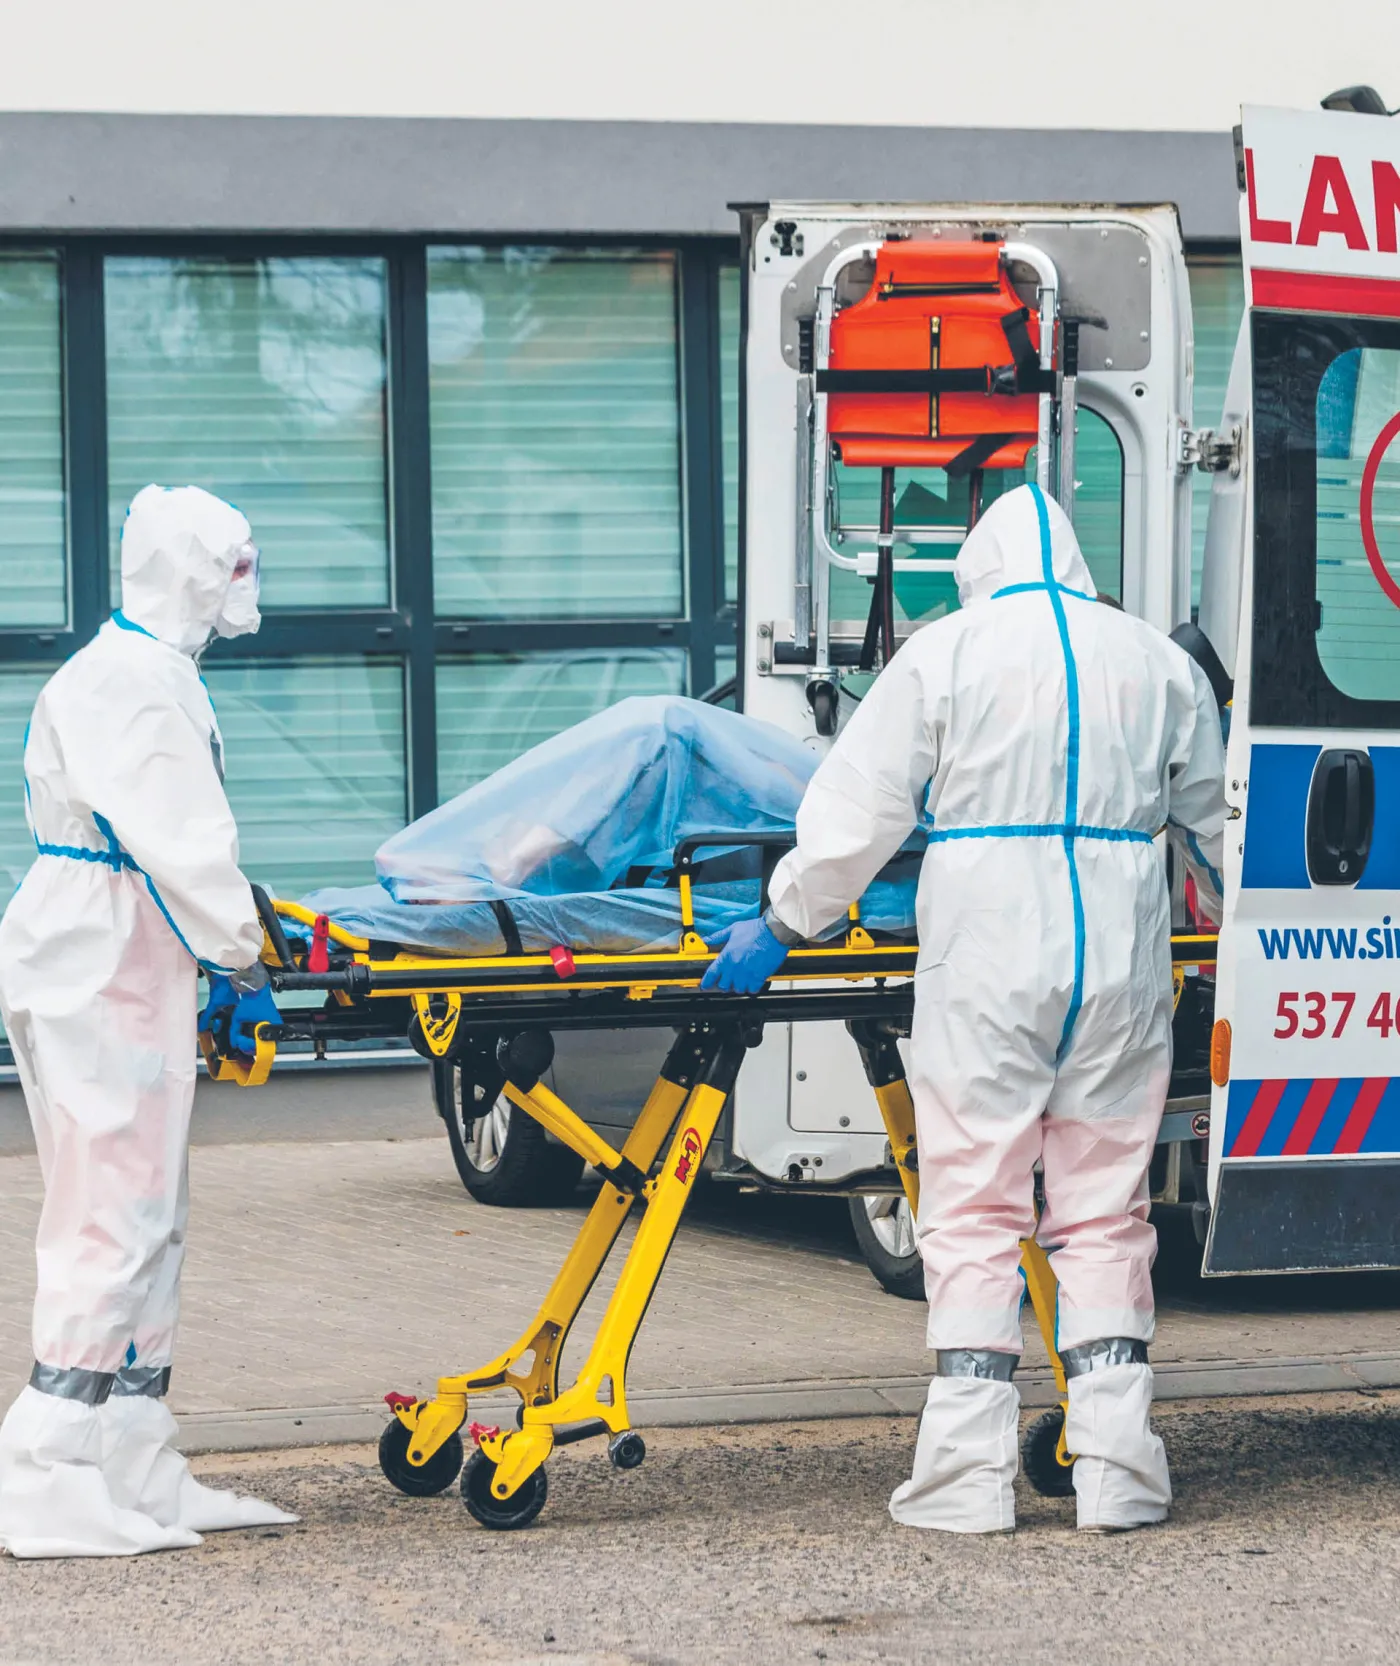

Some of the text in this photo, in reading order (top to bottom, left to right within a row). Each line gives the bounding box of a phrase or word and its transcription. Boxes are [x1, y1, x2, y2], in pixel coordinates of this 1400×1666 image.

[1257, 915, 1400, 960] www.si
[1273, 991, 1400, 1039] 537 4
[674, 1137, 698, 1186] M-1
